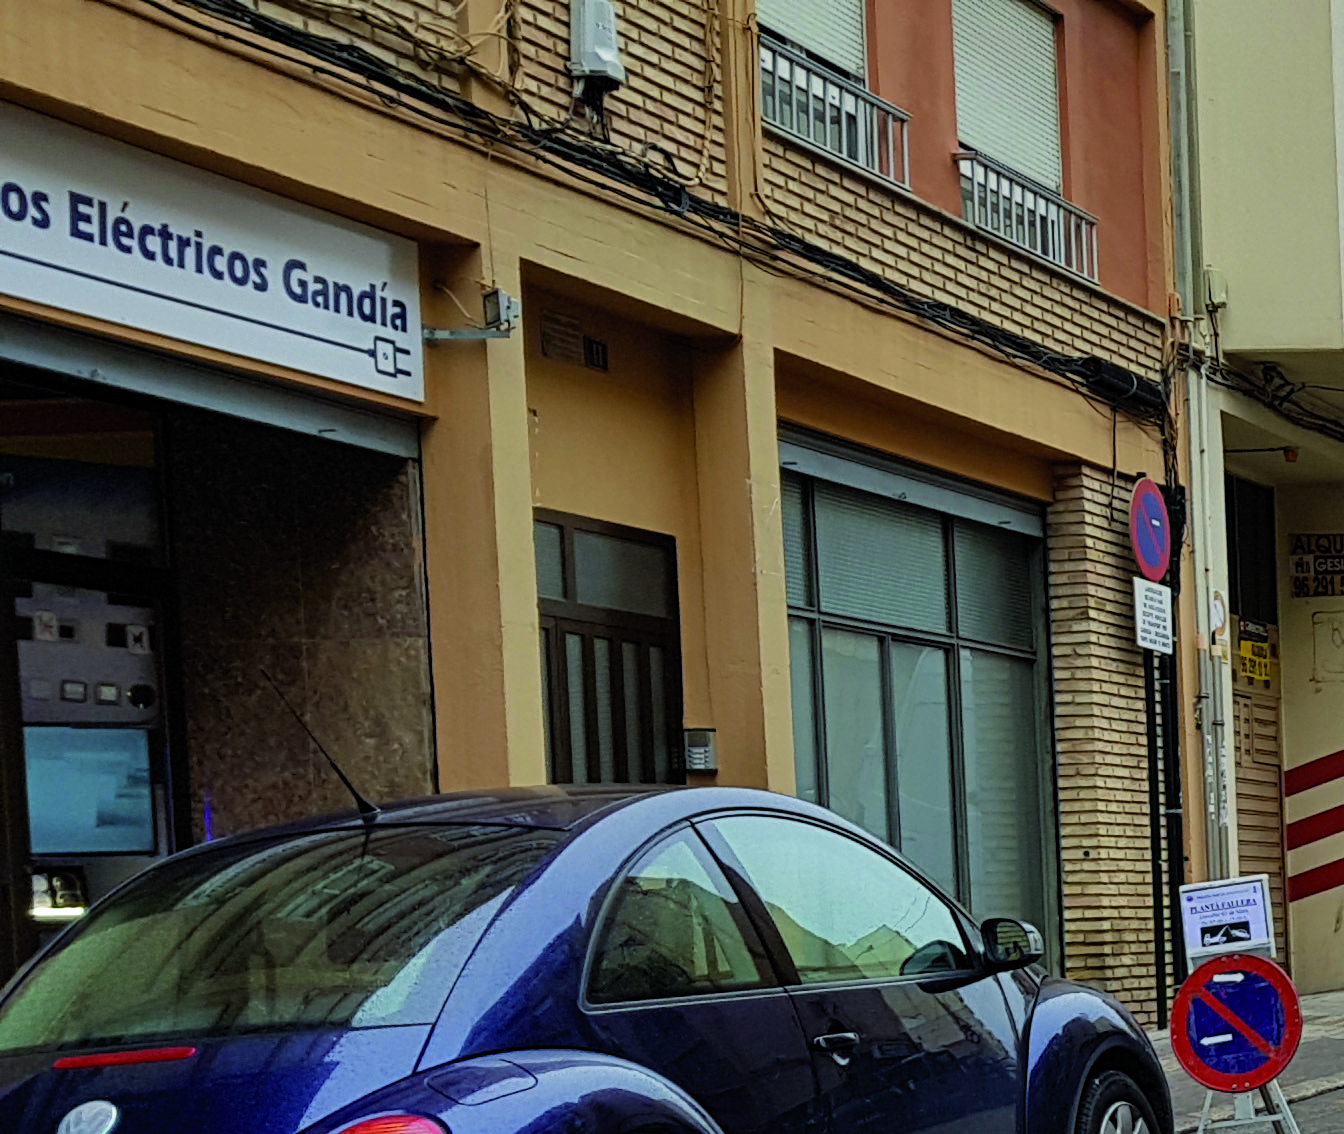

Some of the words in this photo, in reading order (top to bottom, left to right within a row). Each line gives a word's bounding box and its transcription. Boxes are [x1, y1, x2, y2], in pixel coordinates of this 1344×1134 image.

[68, 190, 269, 293] Eléctricos
[282, 258, 409, 333] Gandía
[1293, 575, 1310, 598] 96
[1312, 575, 1336, 597] 291
